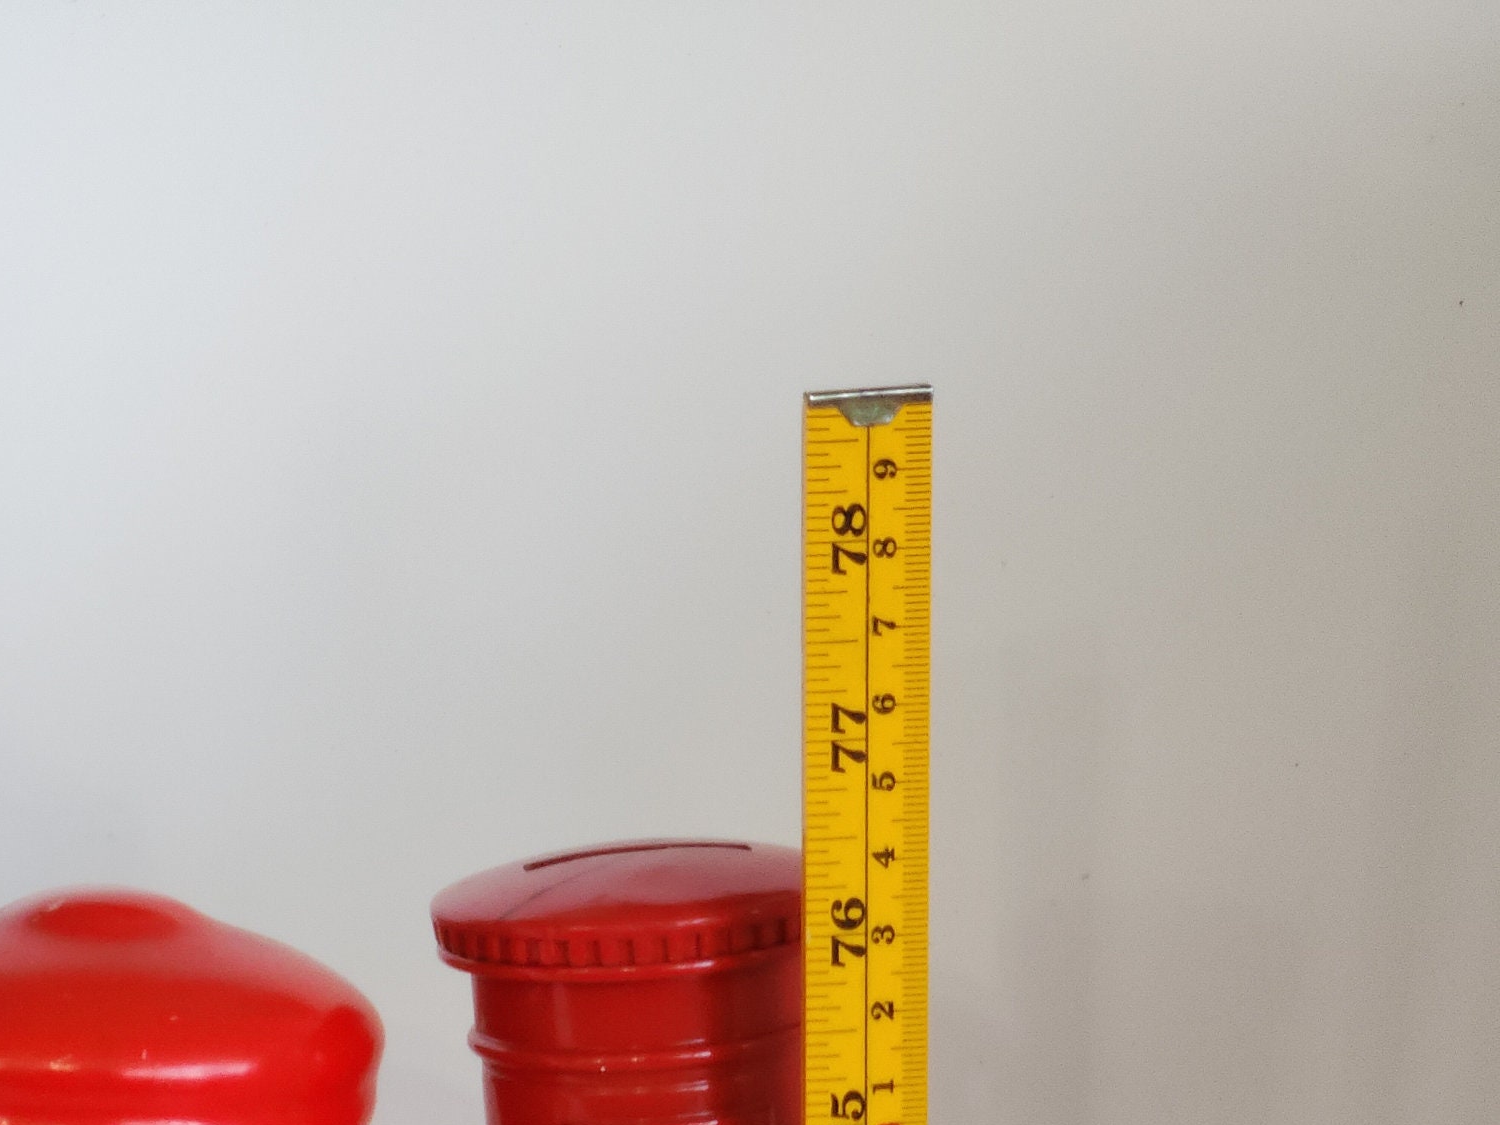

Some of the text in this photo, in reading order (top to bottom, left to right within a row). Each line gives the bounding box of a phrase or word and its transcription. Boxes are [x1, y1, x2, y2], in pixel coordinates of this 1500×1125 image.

[831, 503, 867, 575] 78
[873, 537, 898, 559] 8
[872, 616, 896, 637] 7
[872, 693, 897, 715] 6
[831, 702, 867, 774] 77
[872, 772, 896, 792] 5
[872, 846, 895, 869] 4
[831, 897, 867, 968] 76
[871, 924, 895, 945] 3
[871, 1001, 894, 1021] 2
[873, 1079, 895, 1094] 1
